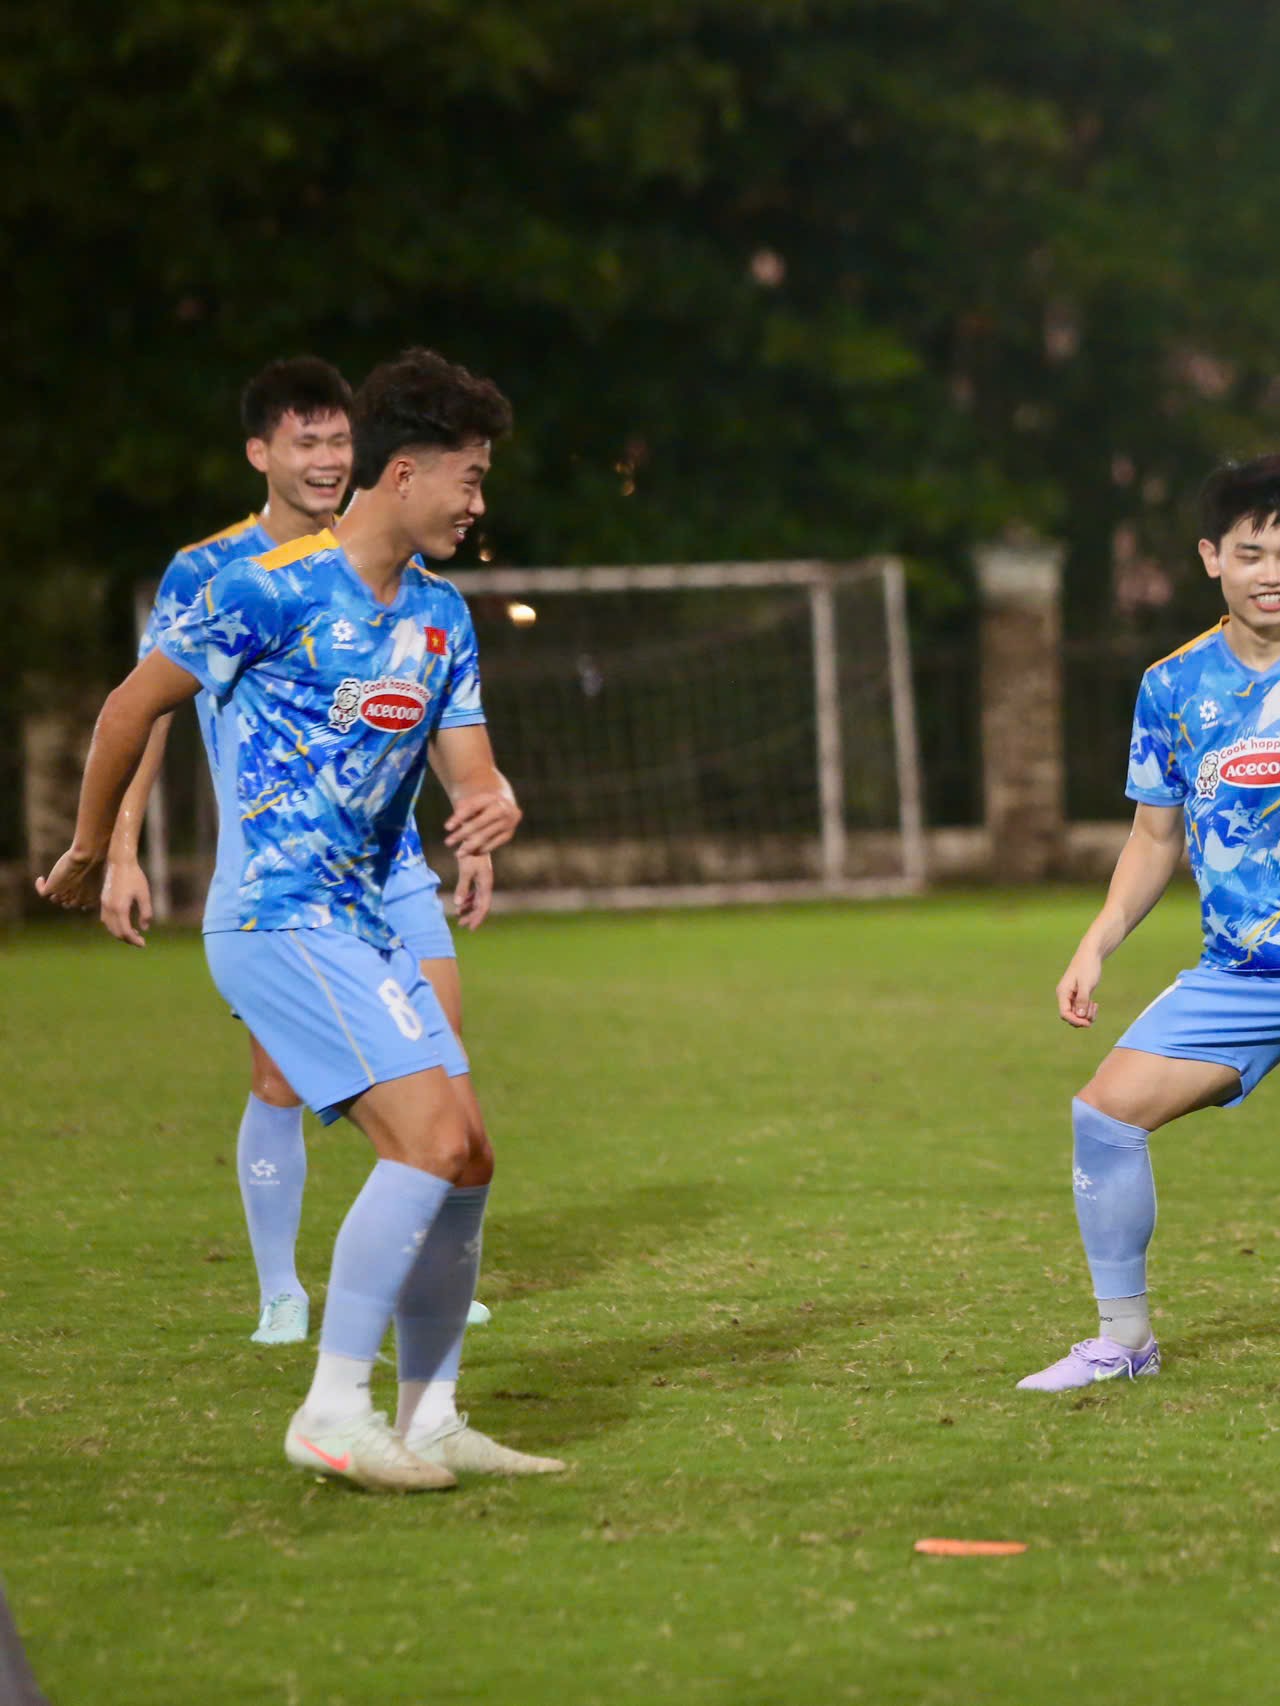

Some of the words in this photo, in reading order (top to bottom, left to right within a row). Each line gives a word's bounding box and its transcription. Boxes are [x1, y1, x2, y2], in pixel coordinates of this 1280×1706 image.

[363, 681, 387, 695] Cook
[1220, 742, 1246, 759] Cook
[378, 978, 423, 1041] 8
